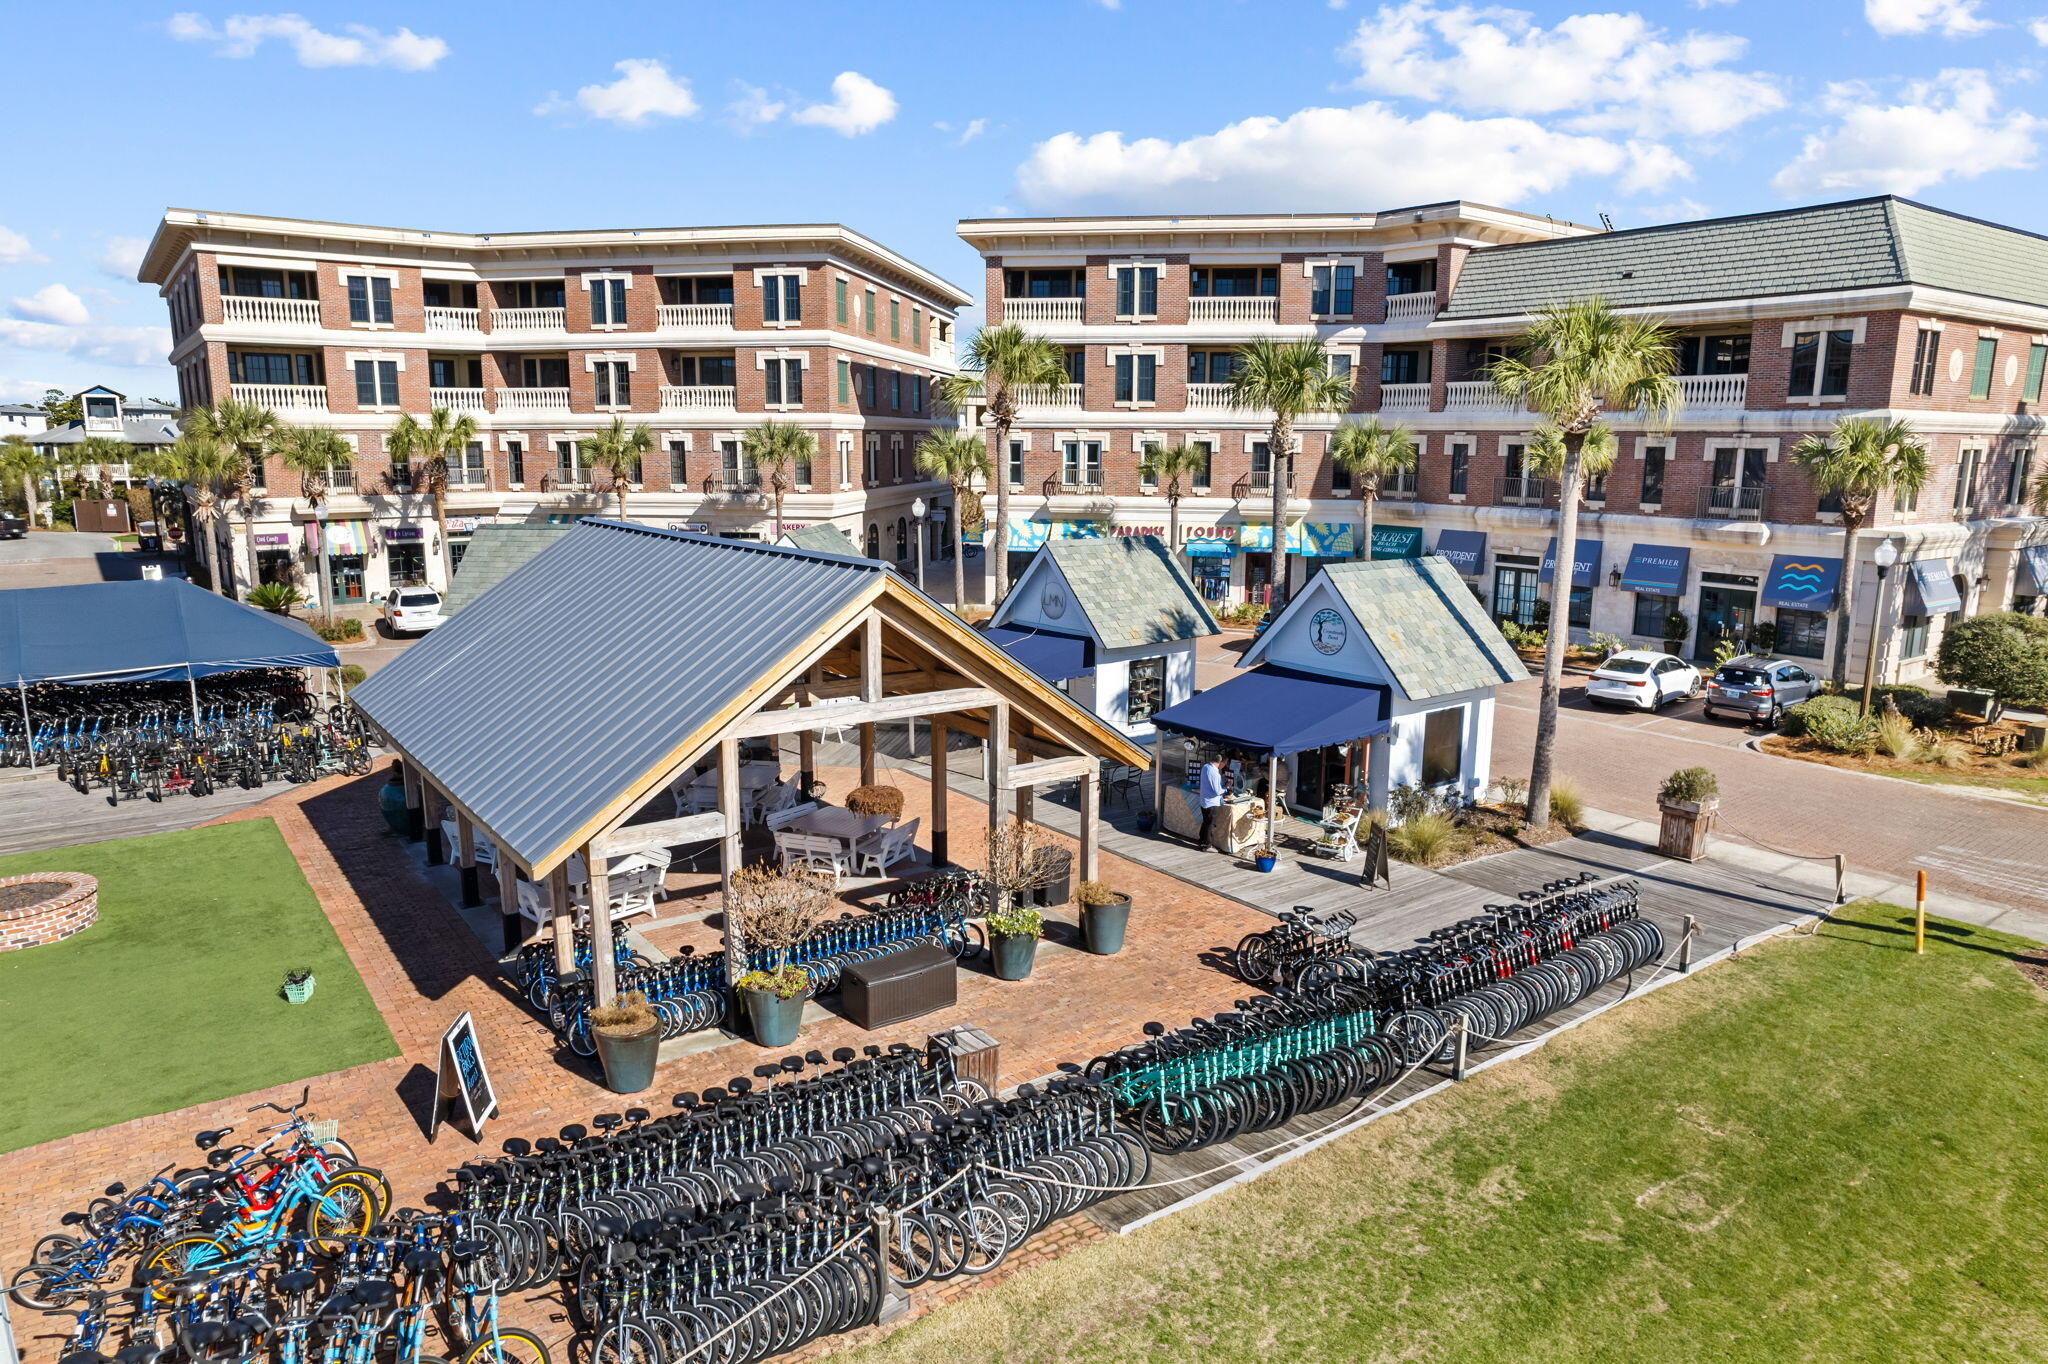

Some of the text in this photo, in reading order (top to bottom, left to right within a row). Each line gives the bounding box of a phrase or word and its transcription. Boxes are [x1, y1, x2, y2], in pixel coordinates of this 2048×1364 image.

[1110, 526, 1236, 538] PARADISE FOUND
[1435, 549, 1477, 560] PROVIDENT
[1544, 559, 1592, 571] PRENT
[1642, 557, 1679, 567] PREMIER
